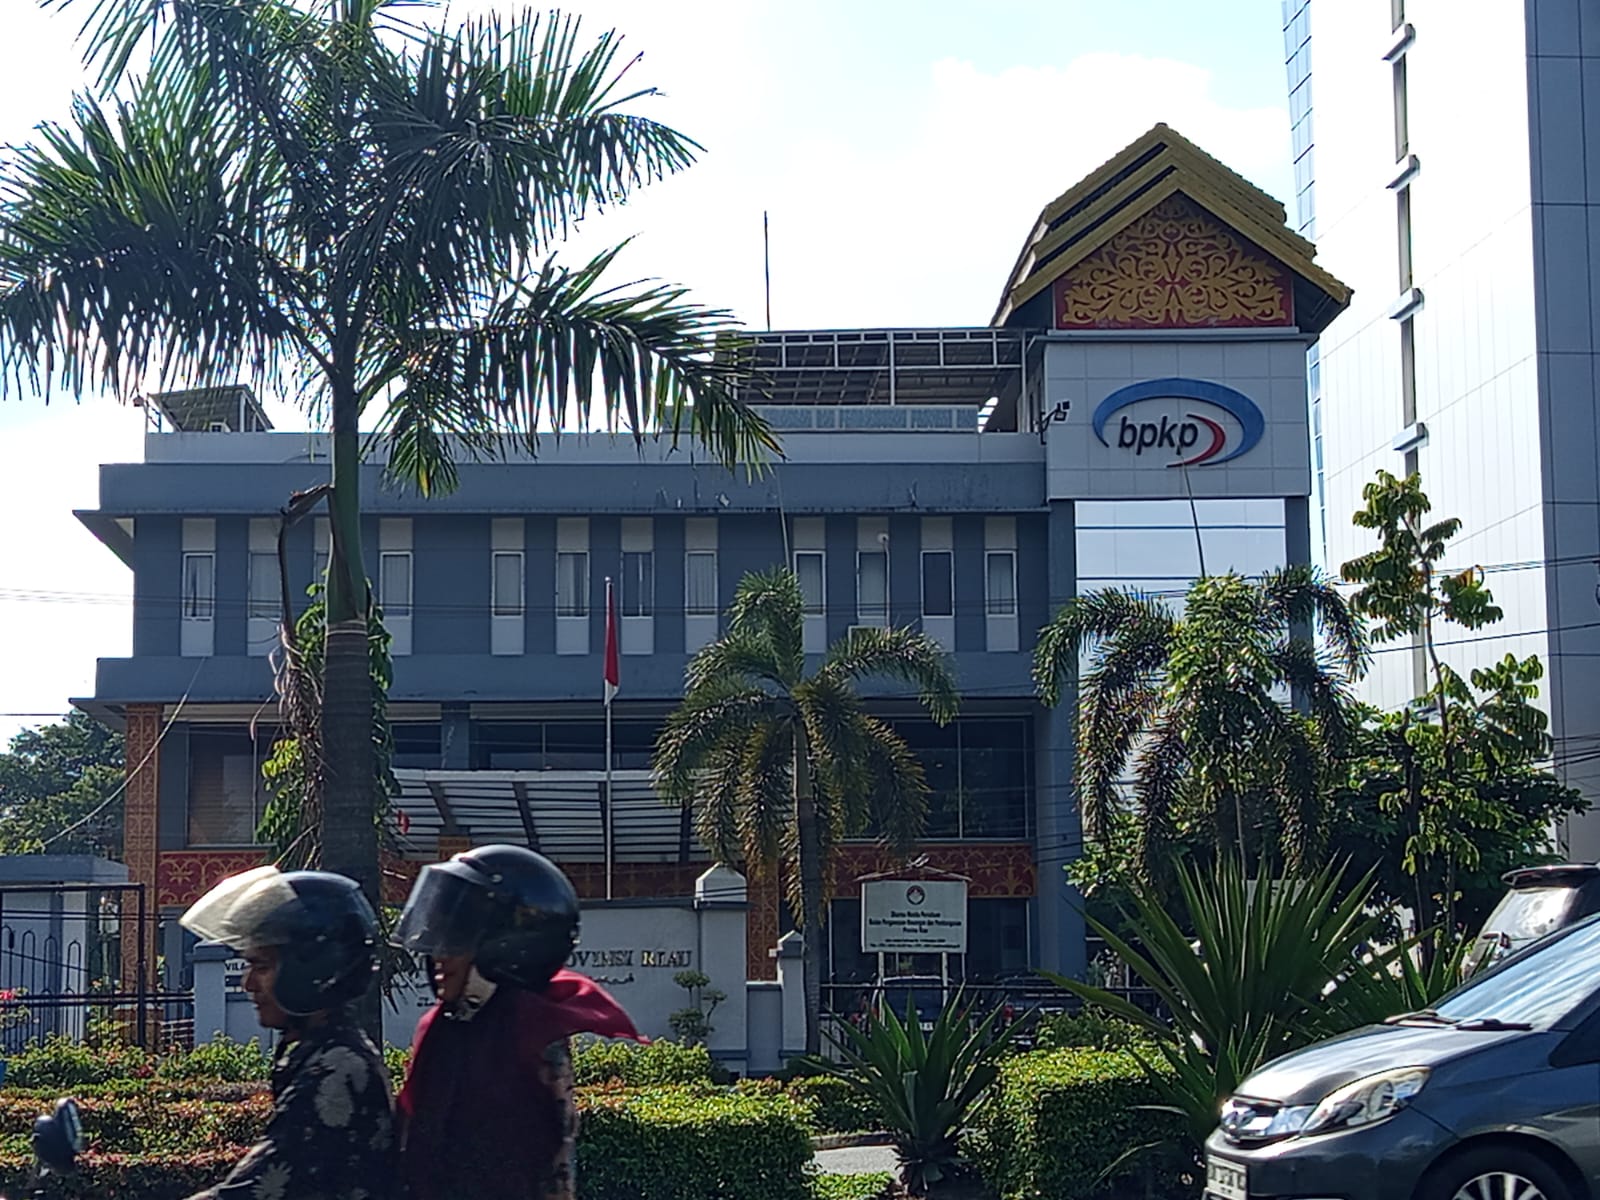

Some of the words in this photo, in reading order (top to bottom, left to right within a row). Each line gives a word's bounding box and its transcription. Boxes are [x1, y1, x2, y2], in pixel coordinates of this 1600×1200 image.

[1118, 415, 1199, 456] bpkp
[566, 950, 633, 968] OVINSI
[641, 950, 693, 968] RIAU
